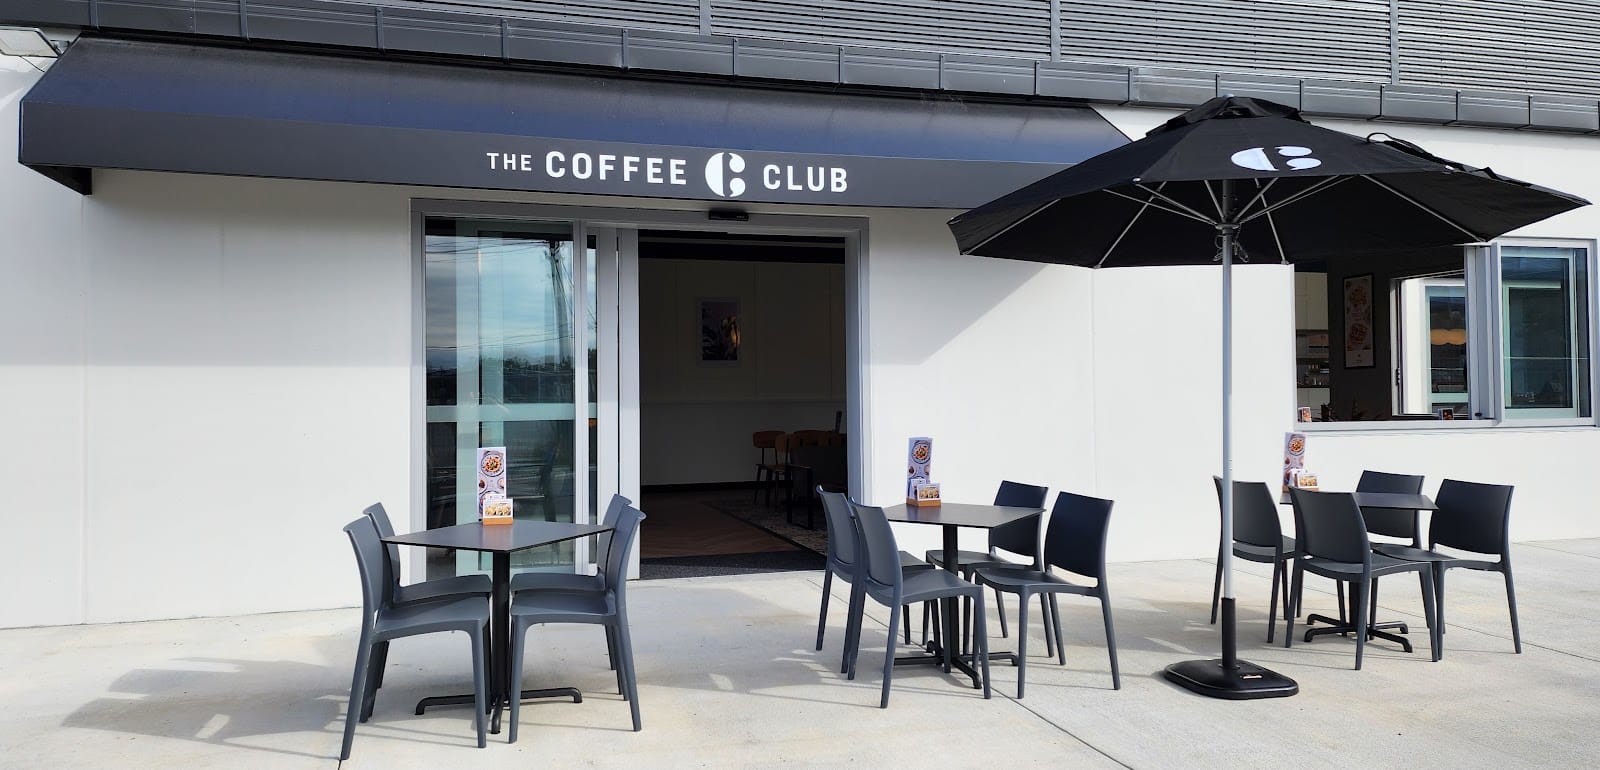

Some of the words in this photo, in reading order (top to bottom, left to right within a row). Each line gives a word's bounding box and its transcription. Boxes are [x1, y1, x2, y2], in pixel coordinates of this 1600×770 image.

[486, 152, 532, 172] THE
[545, 150, 687, 186] COFFEE
[763, 163, 848, 193] CLUB
